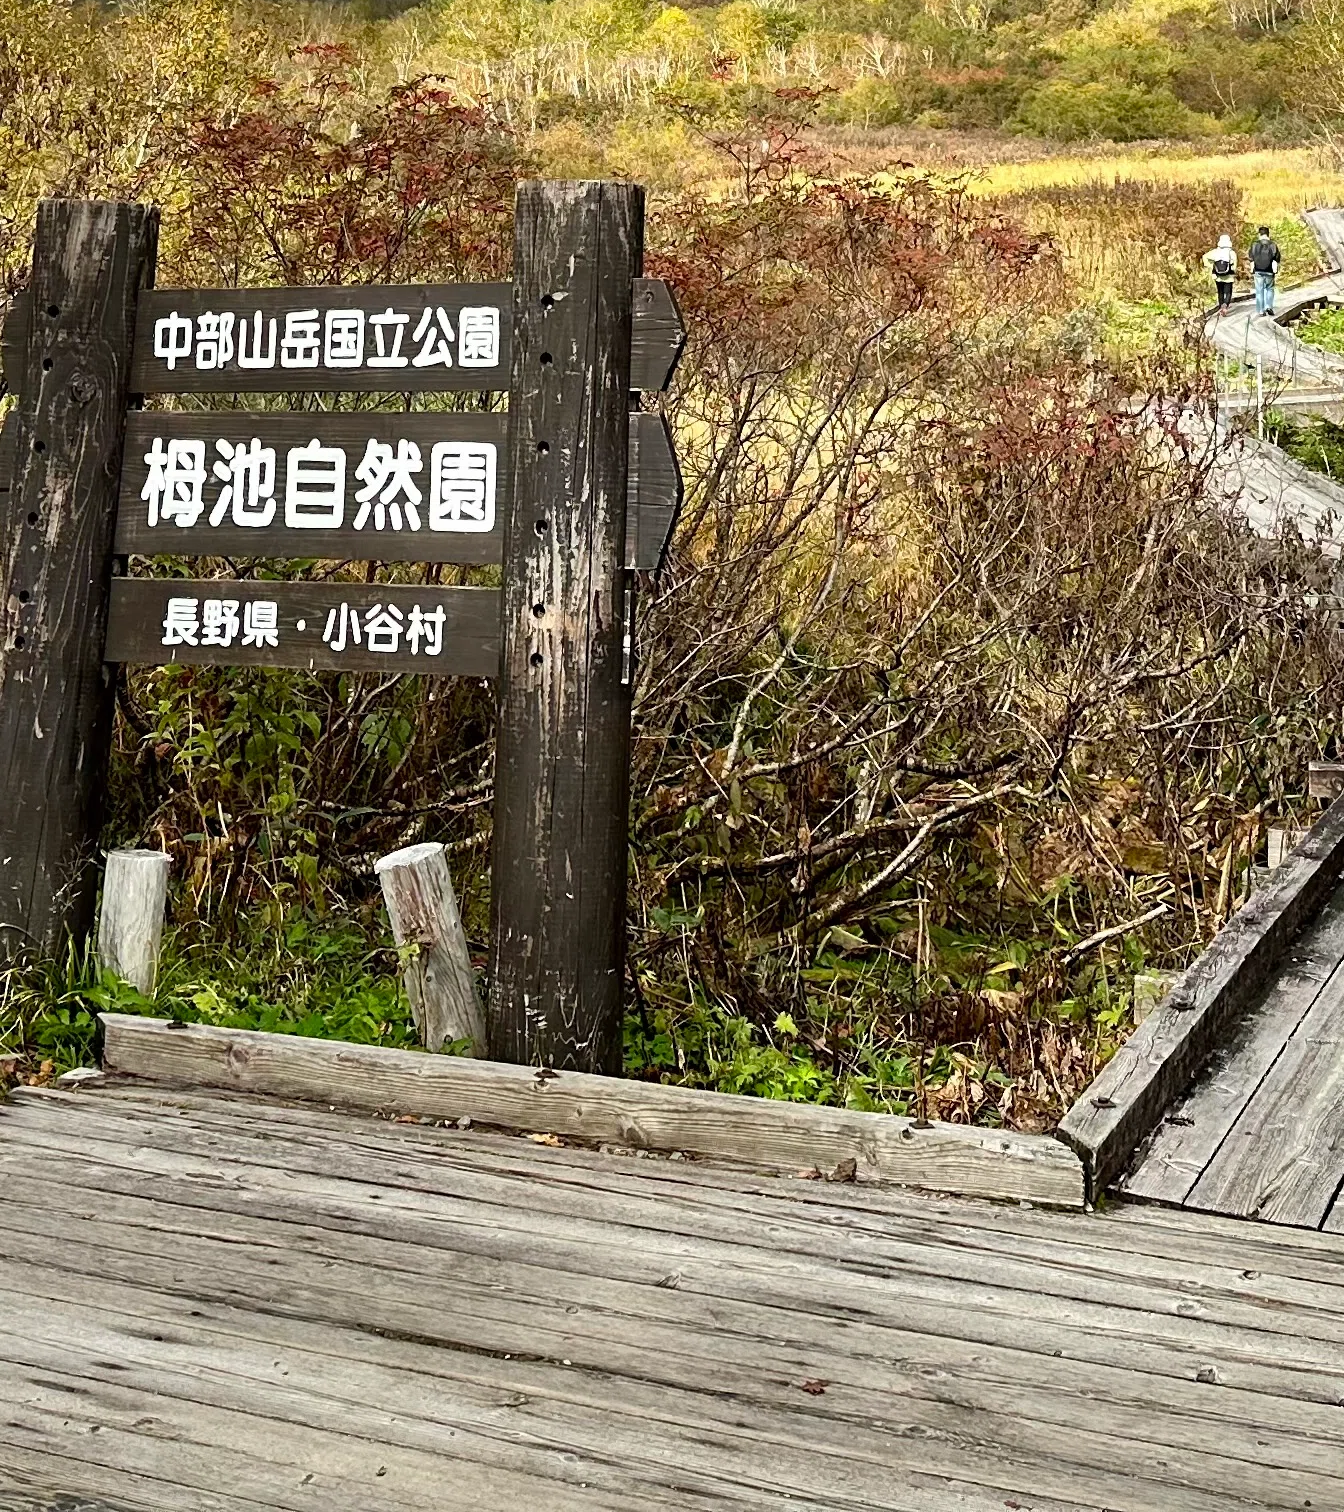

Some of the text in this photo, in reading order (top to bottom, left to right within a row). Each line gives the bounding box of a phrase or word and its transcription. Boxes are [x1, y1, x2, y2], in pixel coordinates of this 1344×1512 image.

[153, 306, 500, 371] 中部山岳国立公園
[140, 437, 498, 533] 栂池自然園
[161, 597, 447, 656] 長野県・小谷村
